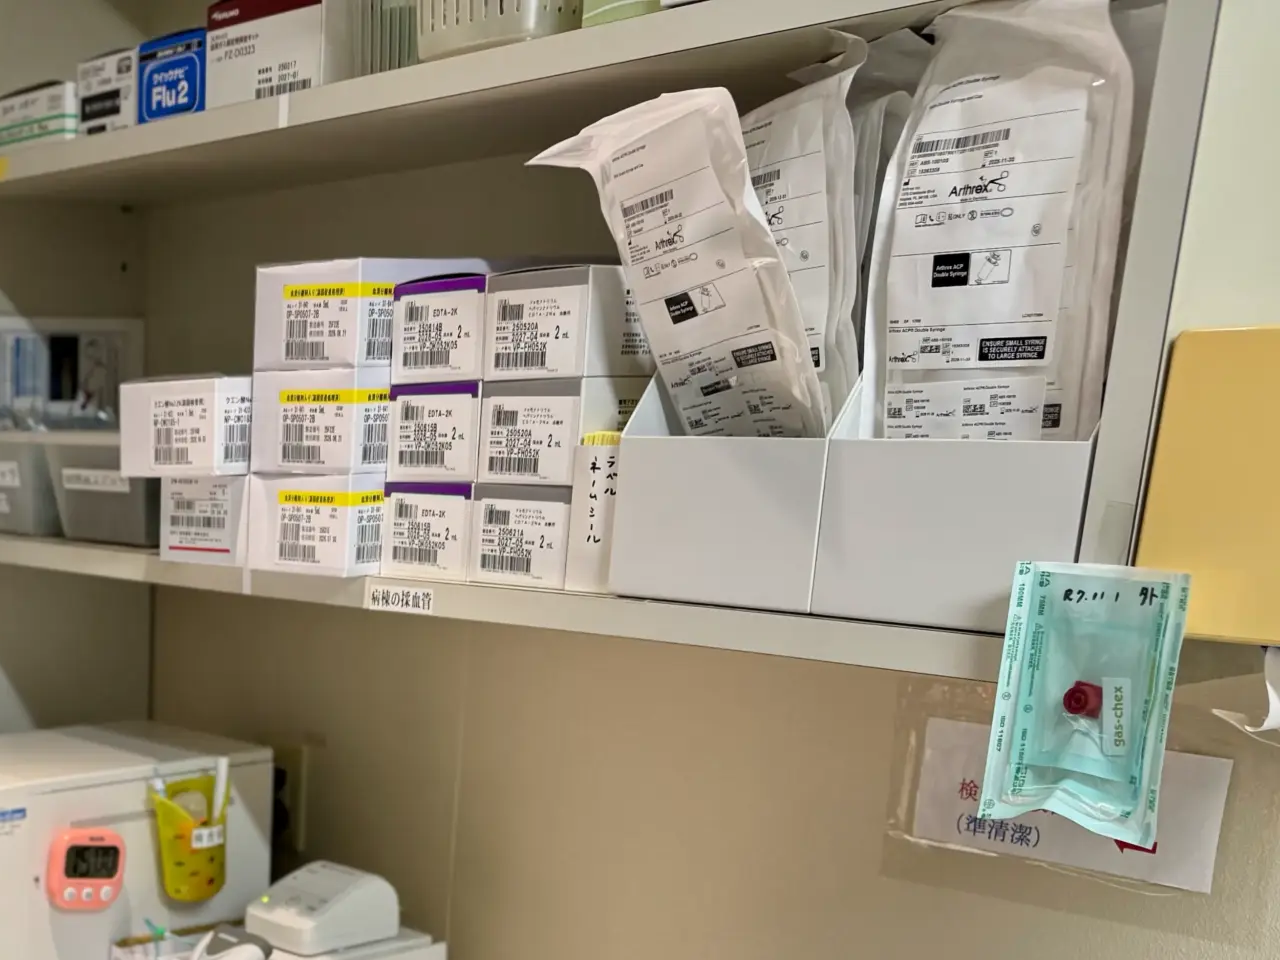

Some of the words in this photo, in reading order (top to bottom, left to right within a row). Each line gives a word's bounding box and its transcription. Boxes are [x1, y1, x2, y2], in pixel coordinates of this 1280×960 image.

[948, 184, 988, 198] Arthrex
[433, 308, 458, 317] EDTA-2K
[457, 325, 462, 339] 2
[555, 325, 560, 340] 2
[982, 339, 1004, 347] ENSURE
[1023, 338, 1045, 346] SYRINGE
[988, 346, 1018, 354] SECURELY
[1018, 345, 1044, 353] ATTACHED
[996, 352, 1017, 360] LARGE
[1017, 351, 1038, 359] SYRINGE
[428, 409, 453, 418] EDTA-2K
[452, 426, 457, 440] 2
[547, 433, 553, 448] 2
[604, 456, 618, 496] ラベル
[422, 509, 446, 518] EDTA-2K
[445, 527, 450, 541] 2
[539, 535, 545, 549] 2
[371, 588, 432, 611] 病棟の採血管
[1139, 586, 1159, 606] 外
[1112, 686, 1126, 748] gas-chex
